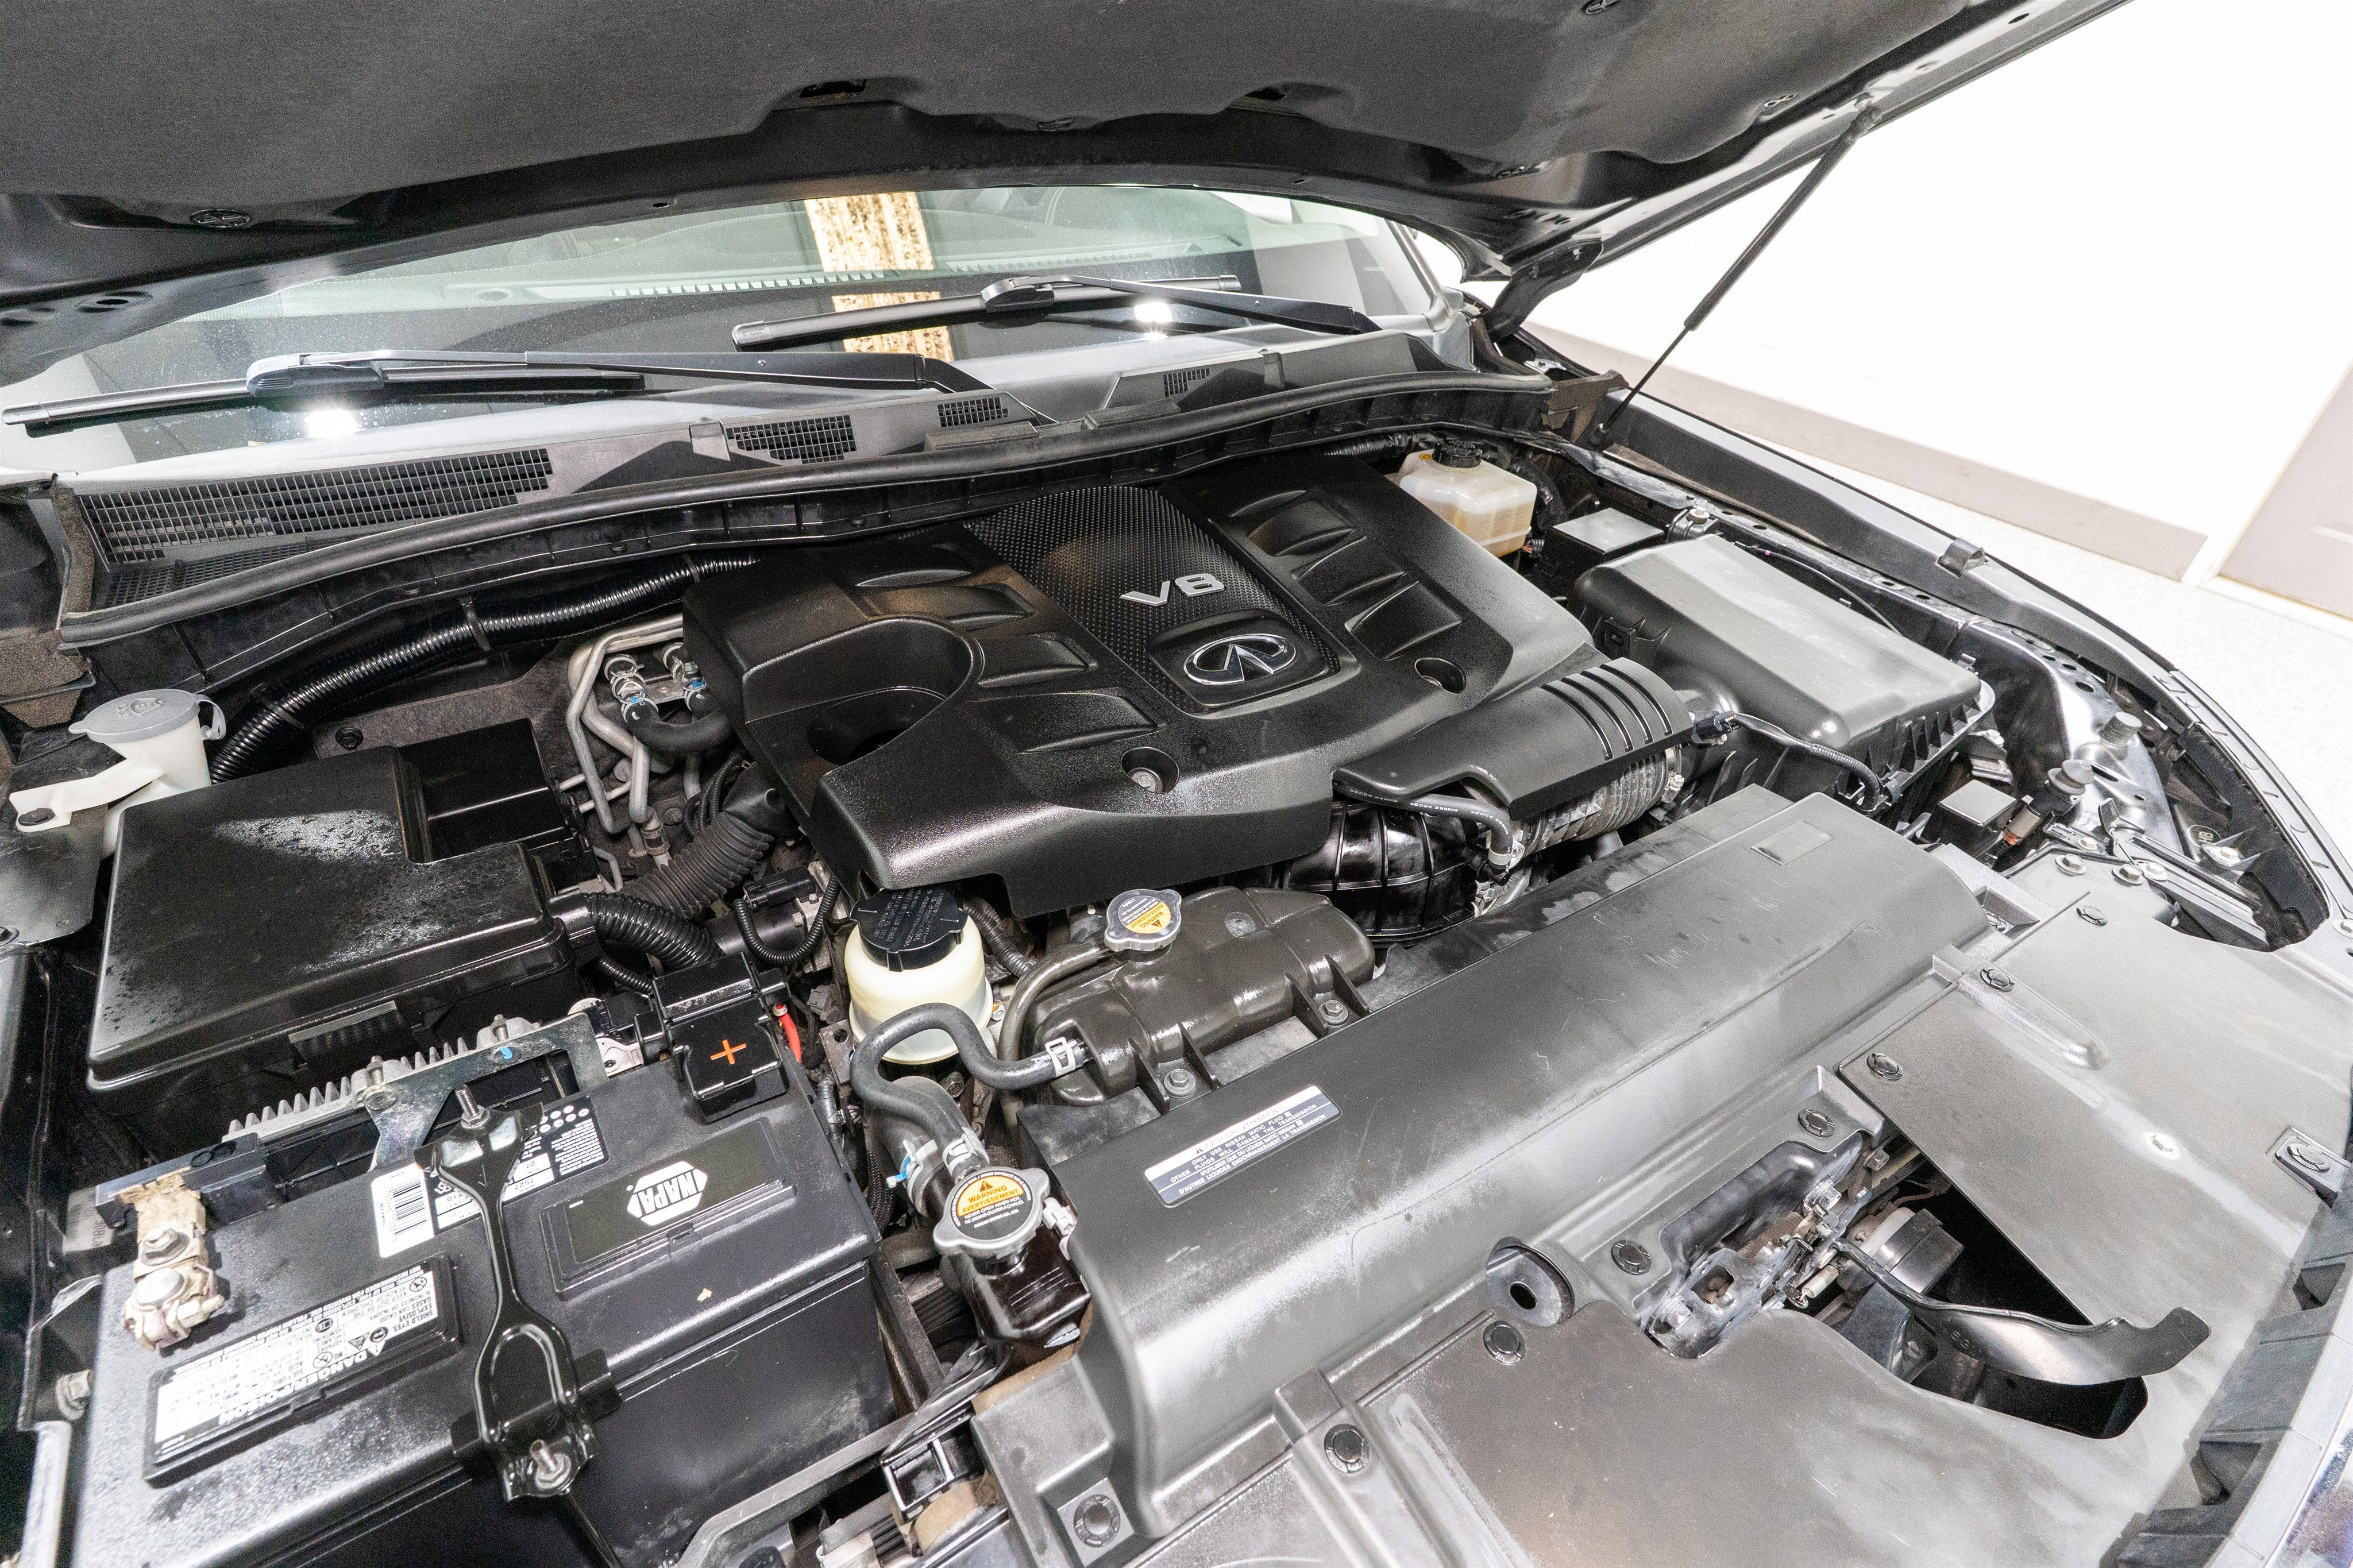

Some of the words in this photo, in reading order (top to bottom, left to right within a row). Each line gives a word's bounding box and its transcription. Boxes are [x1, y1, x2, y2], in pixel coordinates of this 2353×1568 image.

[1120, 573, 1225, 607] V8
[1129, 903, 1163, 928] AVERTISSEMENT
[1139, 910, 1164, 929] WARNING
[1169, 1169, 1191, 1183] OTHER
[1193, 1156, 1216, 1170] FLUIDS
[1217, 1147, 1234, 1157] WILL
[1235, 1133, 1261, 1148] DAMAGE
[1262, 1125, 1276, 1134] THE
[1277, 1103, 1318, 1126] TRANSMISSION
[1190, 1154, 1208, 1165] ONLY
[1209, 1146, 1223, 1156] USE
[1224, 1134, 1247, 1148] NISSAN
[1247, 1124, 1266, 1136] MATIC
[1267, 1114, 1284, 1126] FLUID
[1225, 1153, 1239, 1163] QUE
[1236, 1149, 1247, 1157] DU
[1244, 1140, 1265, 1153] LIQUIDE
[1262, 1131, 1279, 1143] MATIC
[1276, 1123, 1297, 1136] NISSAN
[1177, 1177, 1206, 1195] D'AUTRES
[1205, 1163, 1232, 1180] LIQUIDES
[1230, 1136, 1282, 1167] ENDOMMAGERAIENT
[1289, 1113, 1327, 1136] TRANSMISSION
[524, 1161, 536, 1169] 27
[513, 1177, 535, 1190] 7527
[637, 1170, 697, 1215] NAPA
[967, 1184, 1007, 1203] WARNING
[961, 1188, 1019, 1213] AVERTISSEMENT
[963, 1210, 981, 1219] NEVER
[979, 1204, 995, 1213] OPEN
[375, 1295, 384, 1303] OF
[385, 1285, 406, 1298] REACH
[391, 1291, 407, 1301] KEEP
[400, 1289, 431, 1307] BLINDNESS
[341, 1299, 373, 1318] CHILDREN
[365, 1305, 375, 1313] OF
[376, 1298, 389, 1308] OUT
[390, 1303, 399, 1311] OR
[398, 1306, 410, 1315] CAN
[410, 1296, 431, 1310] GASES
[352, 1309, 365, 1319] THE
[368, 1307, 389, 1321] INJURY
[378, 1311, 397, 1323] CAUSE
[397, 1302, 433, 1323] EXPLOSIVE
[410, 1309, 433, 1324] SHIELD
[333, 1350, 344, 1360] NO
